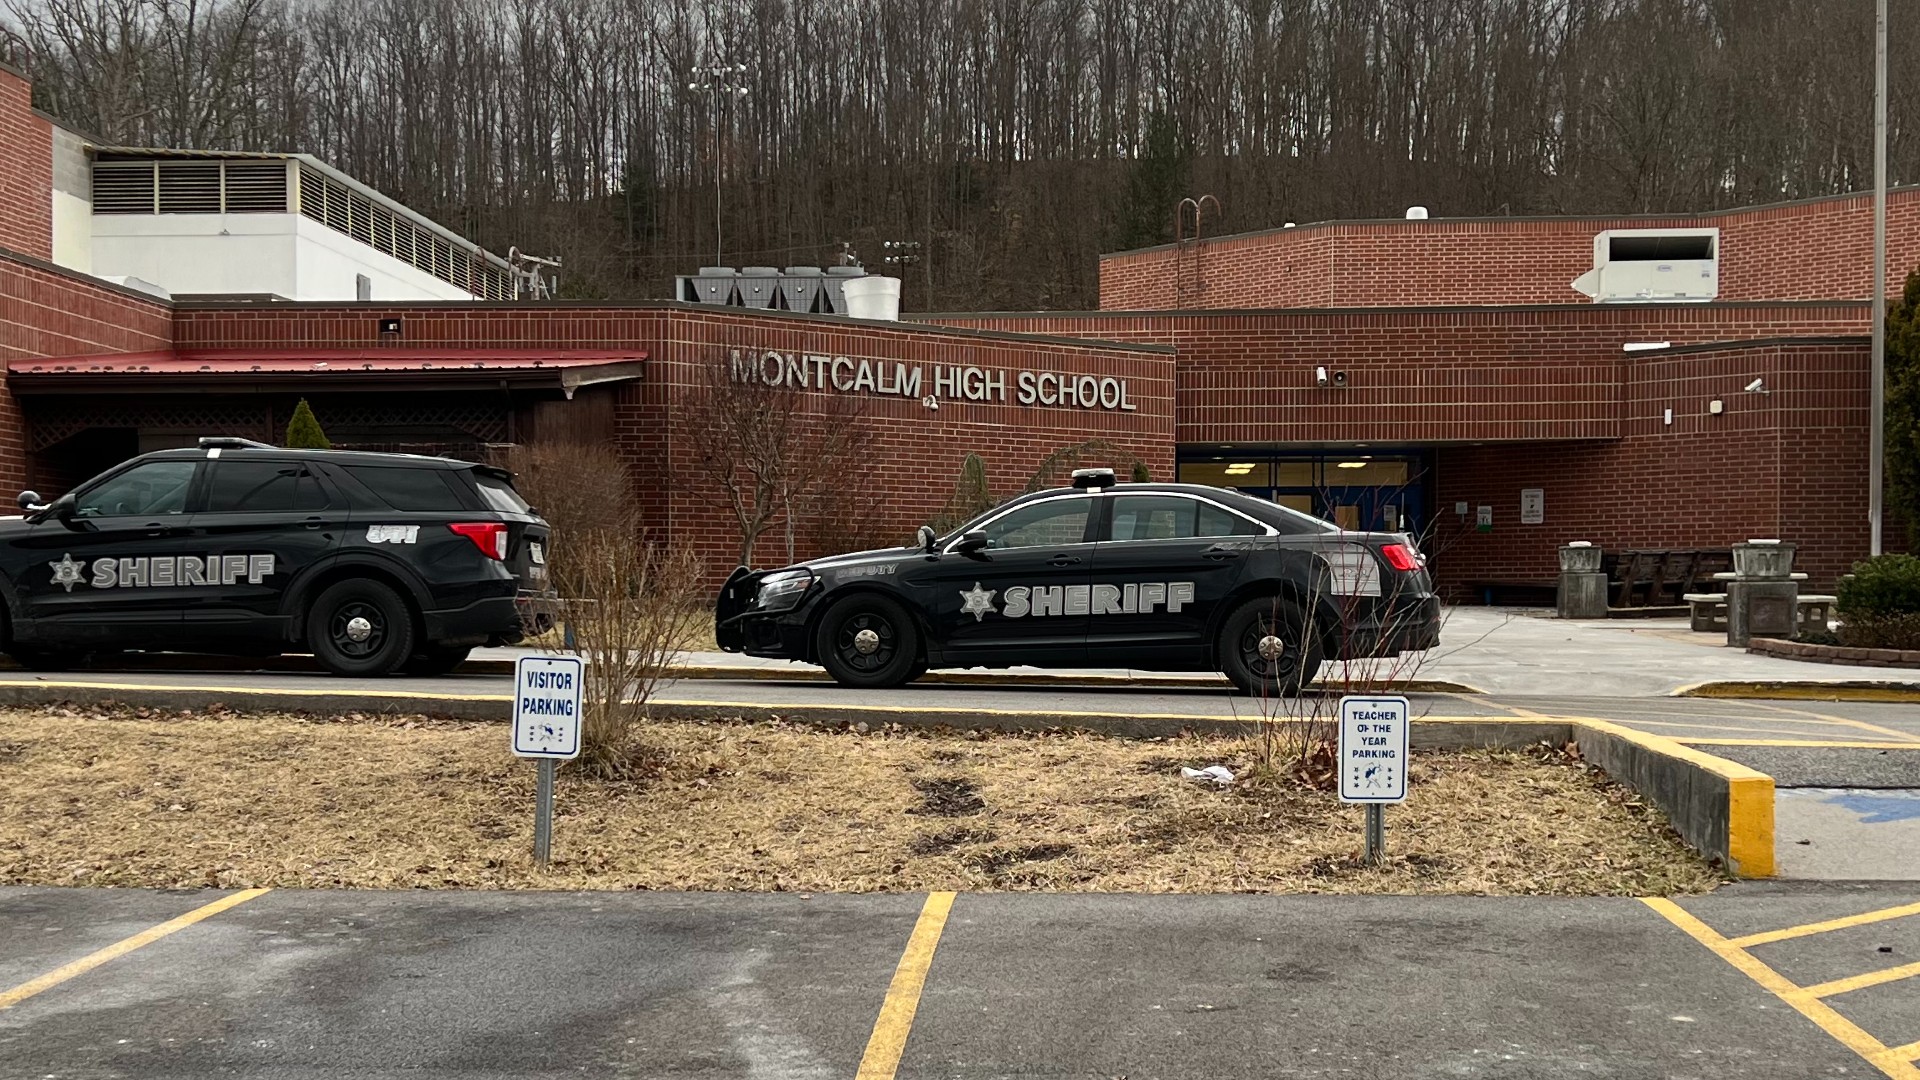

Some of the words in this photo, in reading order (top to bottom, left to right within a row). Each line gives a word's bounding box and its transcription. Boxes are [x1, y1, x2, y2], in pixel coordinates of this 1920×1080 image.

[730, 349, 922, 398] MONTCALM
[934, 366, 1005, 401] HIGH
[1017, 371, 1137, 410] SCHOOL
[91, 554, 275, 588] SHERIFF
[1002, 582, 1195, 617] SHERIFF
[527, 671, 572, 690] VISITOR
[522, 697, 573, 716] PARKING
[1352, 711, 1397, 720] TEACHER
[1357, 724, 1369, 733] OF
[1372, 724, 1392, 733] THE
[1361, 737, 1387, 746] YEAR
[1352, 750, 1396, 759] PARKING
